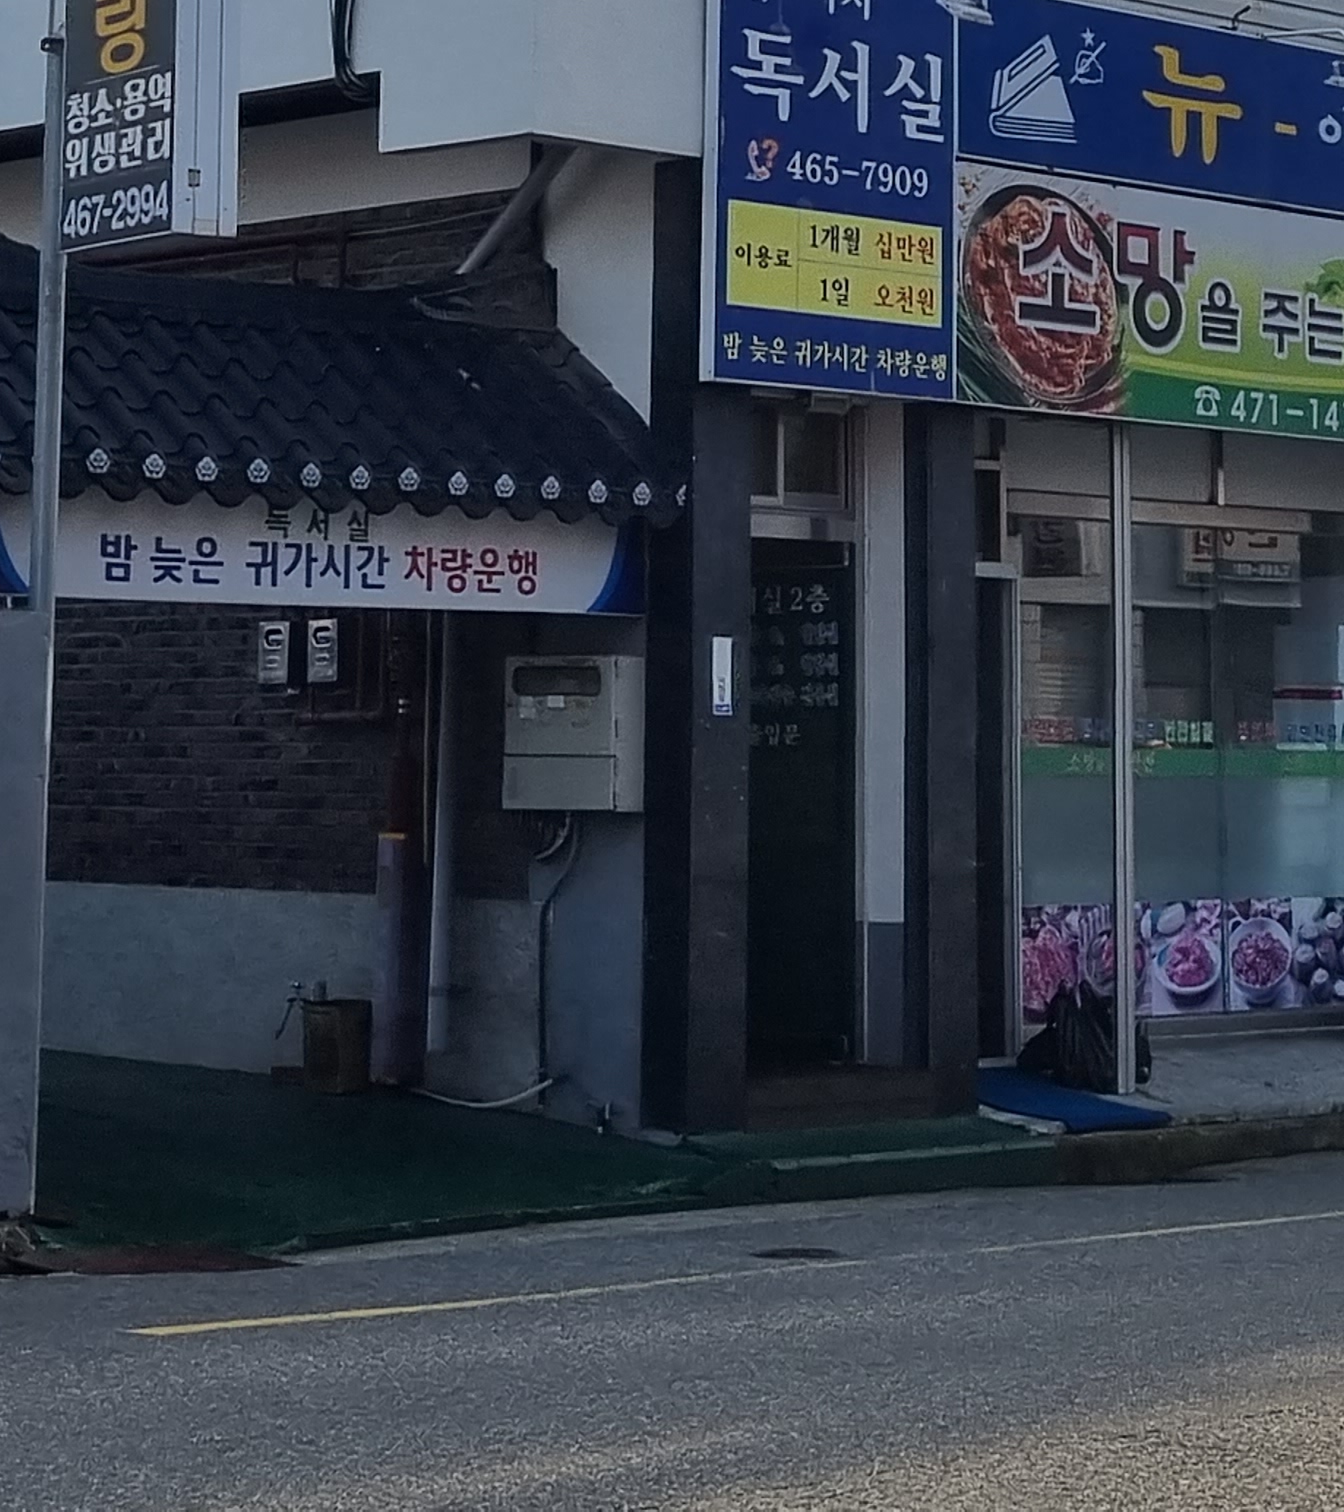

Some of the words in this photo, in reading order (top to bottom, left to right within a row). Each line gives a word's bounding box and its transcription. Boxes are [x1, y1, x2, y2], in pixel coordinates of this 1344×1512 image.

[729, 26, 946, 144] 독서실
[64, 118, 171, 179] 위생관리
[786, 149, 929, 199] 465-7909
[62, 179, 169, 239] 467-2994
[734, 242, 793, 269] 이용료
[809, 224, 861, 256] 1개월
[874, 231, 935, 266] 십만원
[819, 276, 850, 307] 1일
[873, 284, 935, 317] 오천원
[1016, 207, 1242, 355] 소망을
[722, 331, 743, 361] 밤
[748, 335, 789, 365] 늦은
[794, 338, 870, 374] 귀가시간
[876, 347, 948, 382] 차량운행
[264, 507, 370, 543] 독서실
[98, 532, 138, 585] 밤
[148, 534, 224, 586] 늦은
[244, 539, 391, 590] 귀가시간
[403, 544, 538, 596] 차량운행
